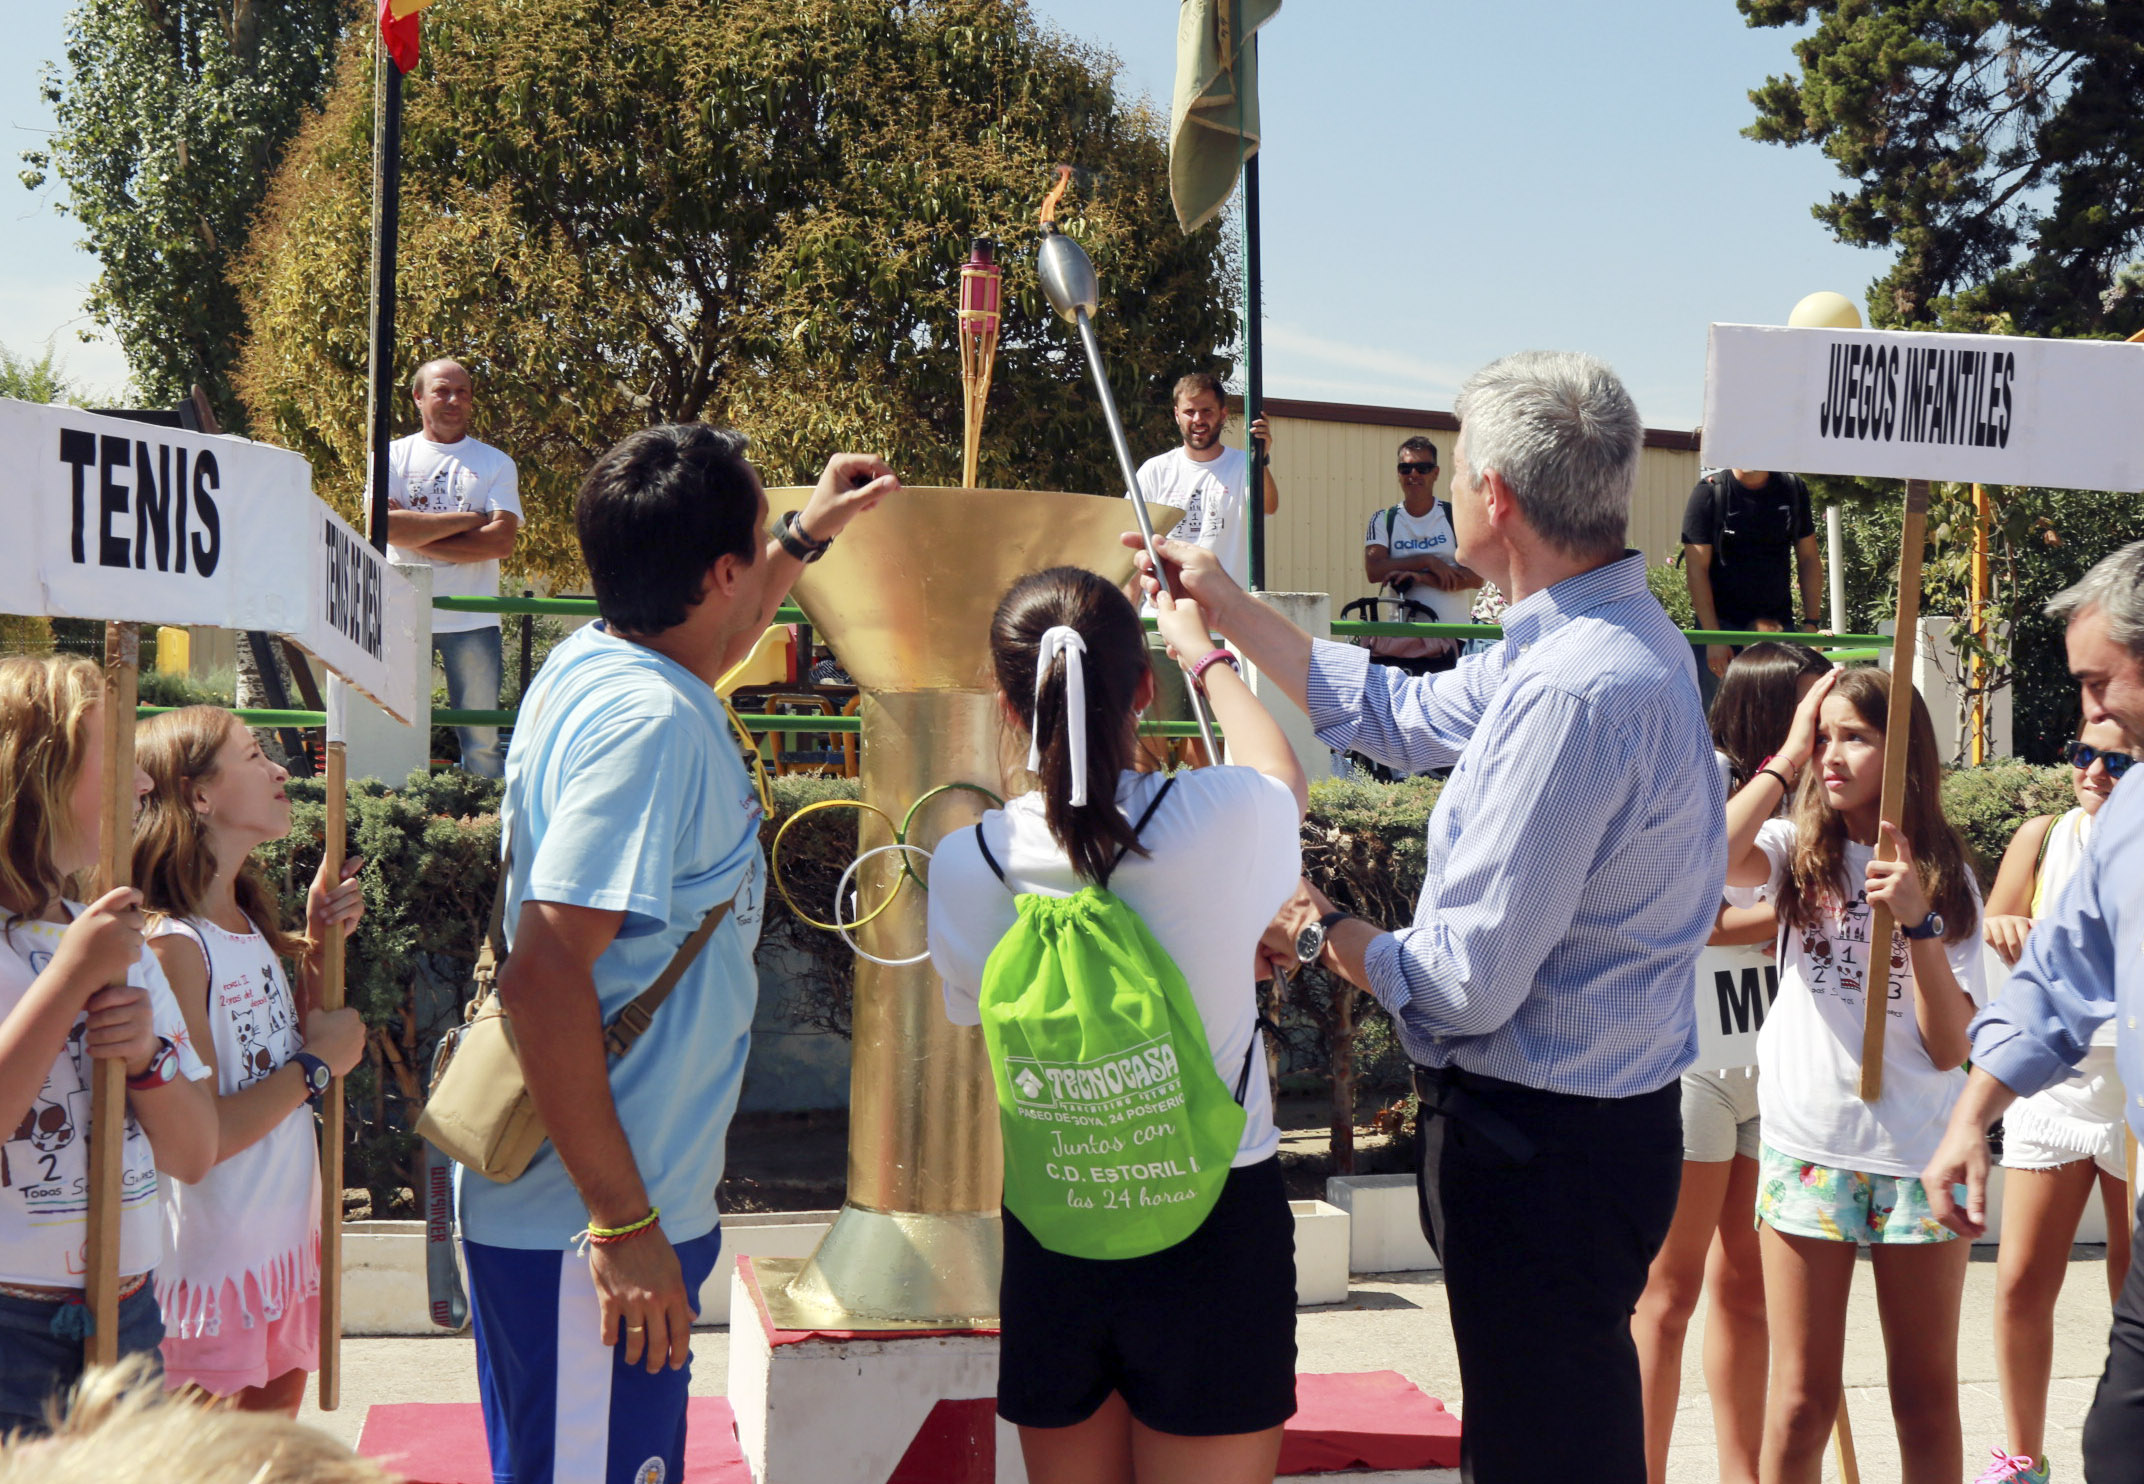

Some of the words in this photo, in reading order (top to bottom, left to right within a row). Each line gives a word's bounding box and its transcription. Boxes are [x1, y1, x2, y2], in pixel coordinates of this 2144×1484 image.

[1820, 343, 1899, 442] JUEGOS
[1901, 347, 2015, 450] INFANTILES
[60, 427, 221, 578] TENIS
[1394, 534, 1447, 550] adidas
[325, 518, 349, 637] TENIS
[350, 541, 360, 645] DE
[362, 551, 382, 662] MESA
[1841, 945, 1857, 964] 1
[1811, 966, 1827, 984] 2
[1045, 1043, 1179, 1100] TECNOCASA
[1017, 1106, 1053, 1121] PASEO
[1055, 1112, 1072, 1123] DE
[1108, 1111, 1125, 1124] 24
[1050, 1130, 1124, 1157] Juntos
[1133, 1123, 1176, 1145] con
[37, 1153, 62, 1182] 2
[1046, 1162, 1087, 1182] C.D.
[1090, 1160, 1186, 1183] ESTORIL
[1067, 1187, 1095, 1209] las
[1103, 1187, 1132, 1209] 24
[1139, 1186, 1197, 1207] horas
